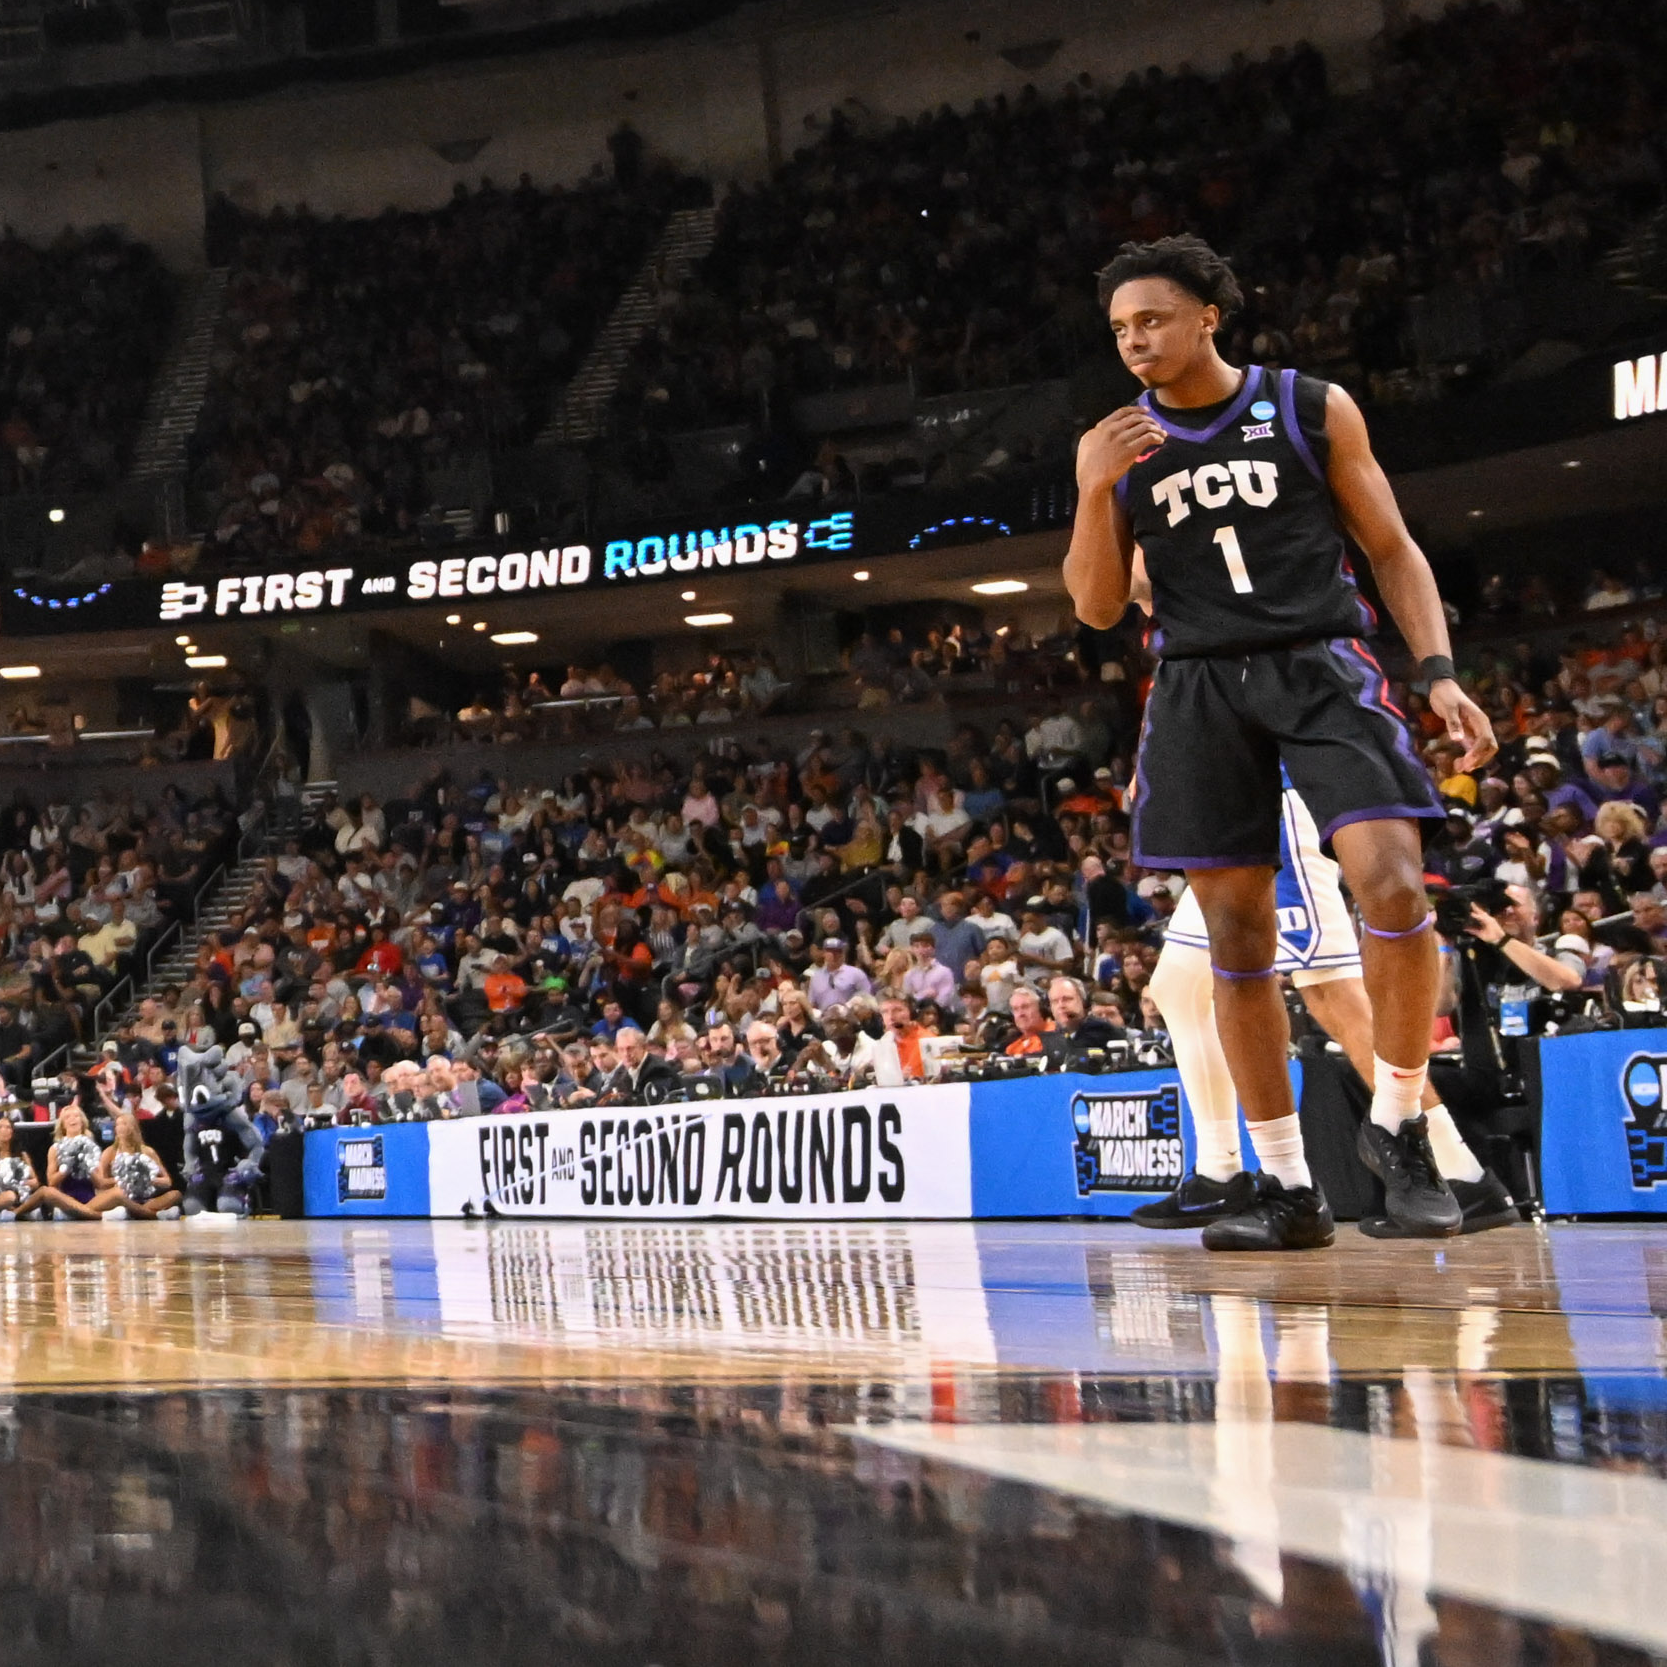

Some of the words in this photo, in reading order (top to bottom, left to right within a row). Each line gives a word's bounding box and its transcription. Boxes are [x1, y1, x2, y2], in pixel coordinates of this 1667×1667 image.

[1151, 460, 1279, 528] TCU
[214, 567, 354, 616] FIRST
[361, 576, 396, 594] AND
[406, 544, 591, 599] SECOND
[604, 520, 799, 580] ROUNDS
[1213, 525, 1254, 594] 1
[1088, 1099, 1149, 1139] MARCH
[344, 1142, 374, 1167] MARCH
[478, 1122, 550, 1207] FIRST
[551, 1146, 575, 1182] AND
[579, 1113, 708, 1207] SECOND
[714, 1102, 907, 1205] ROUNDS
[1098, 1137, 1183, 1178] MADNESS
